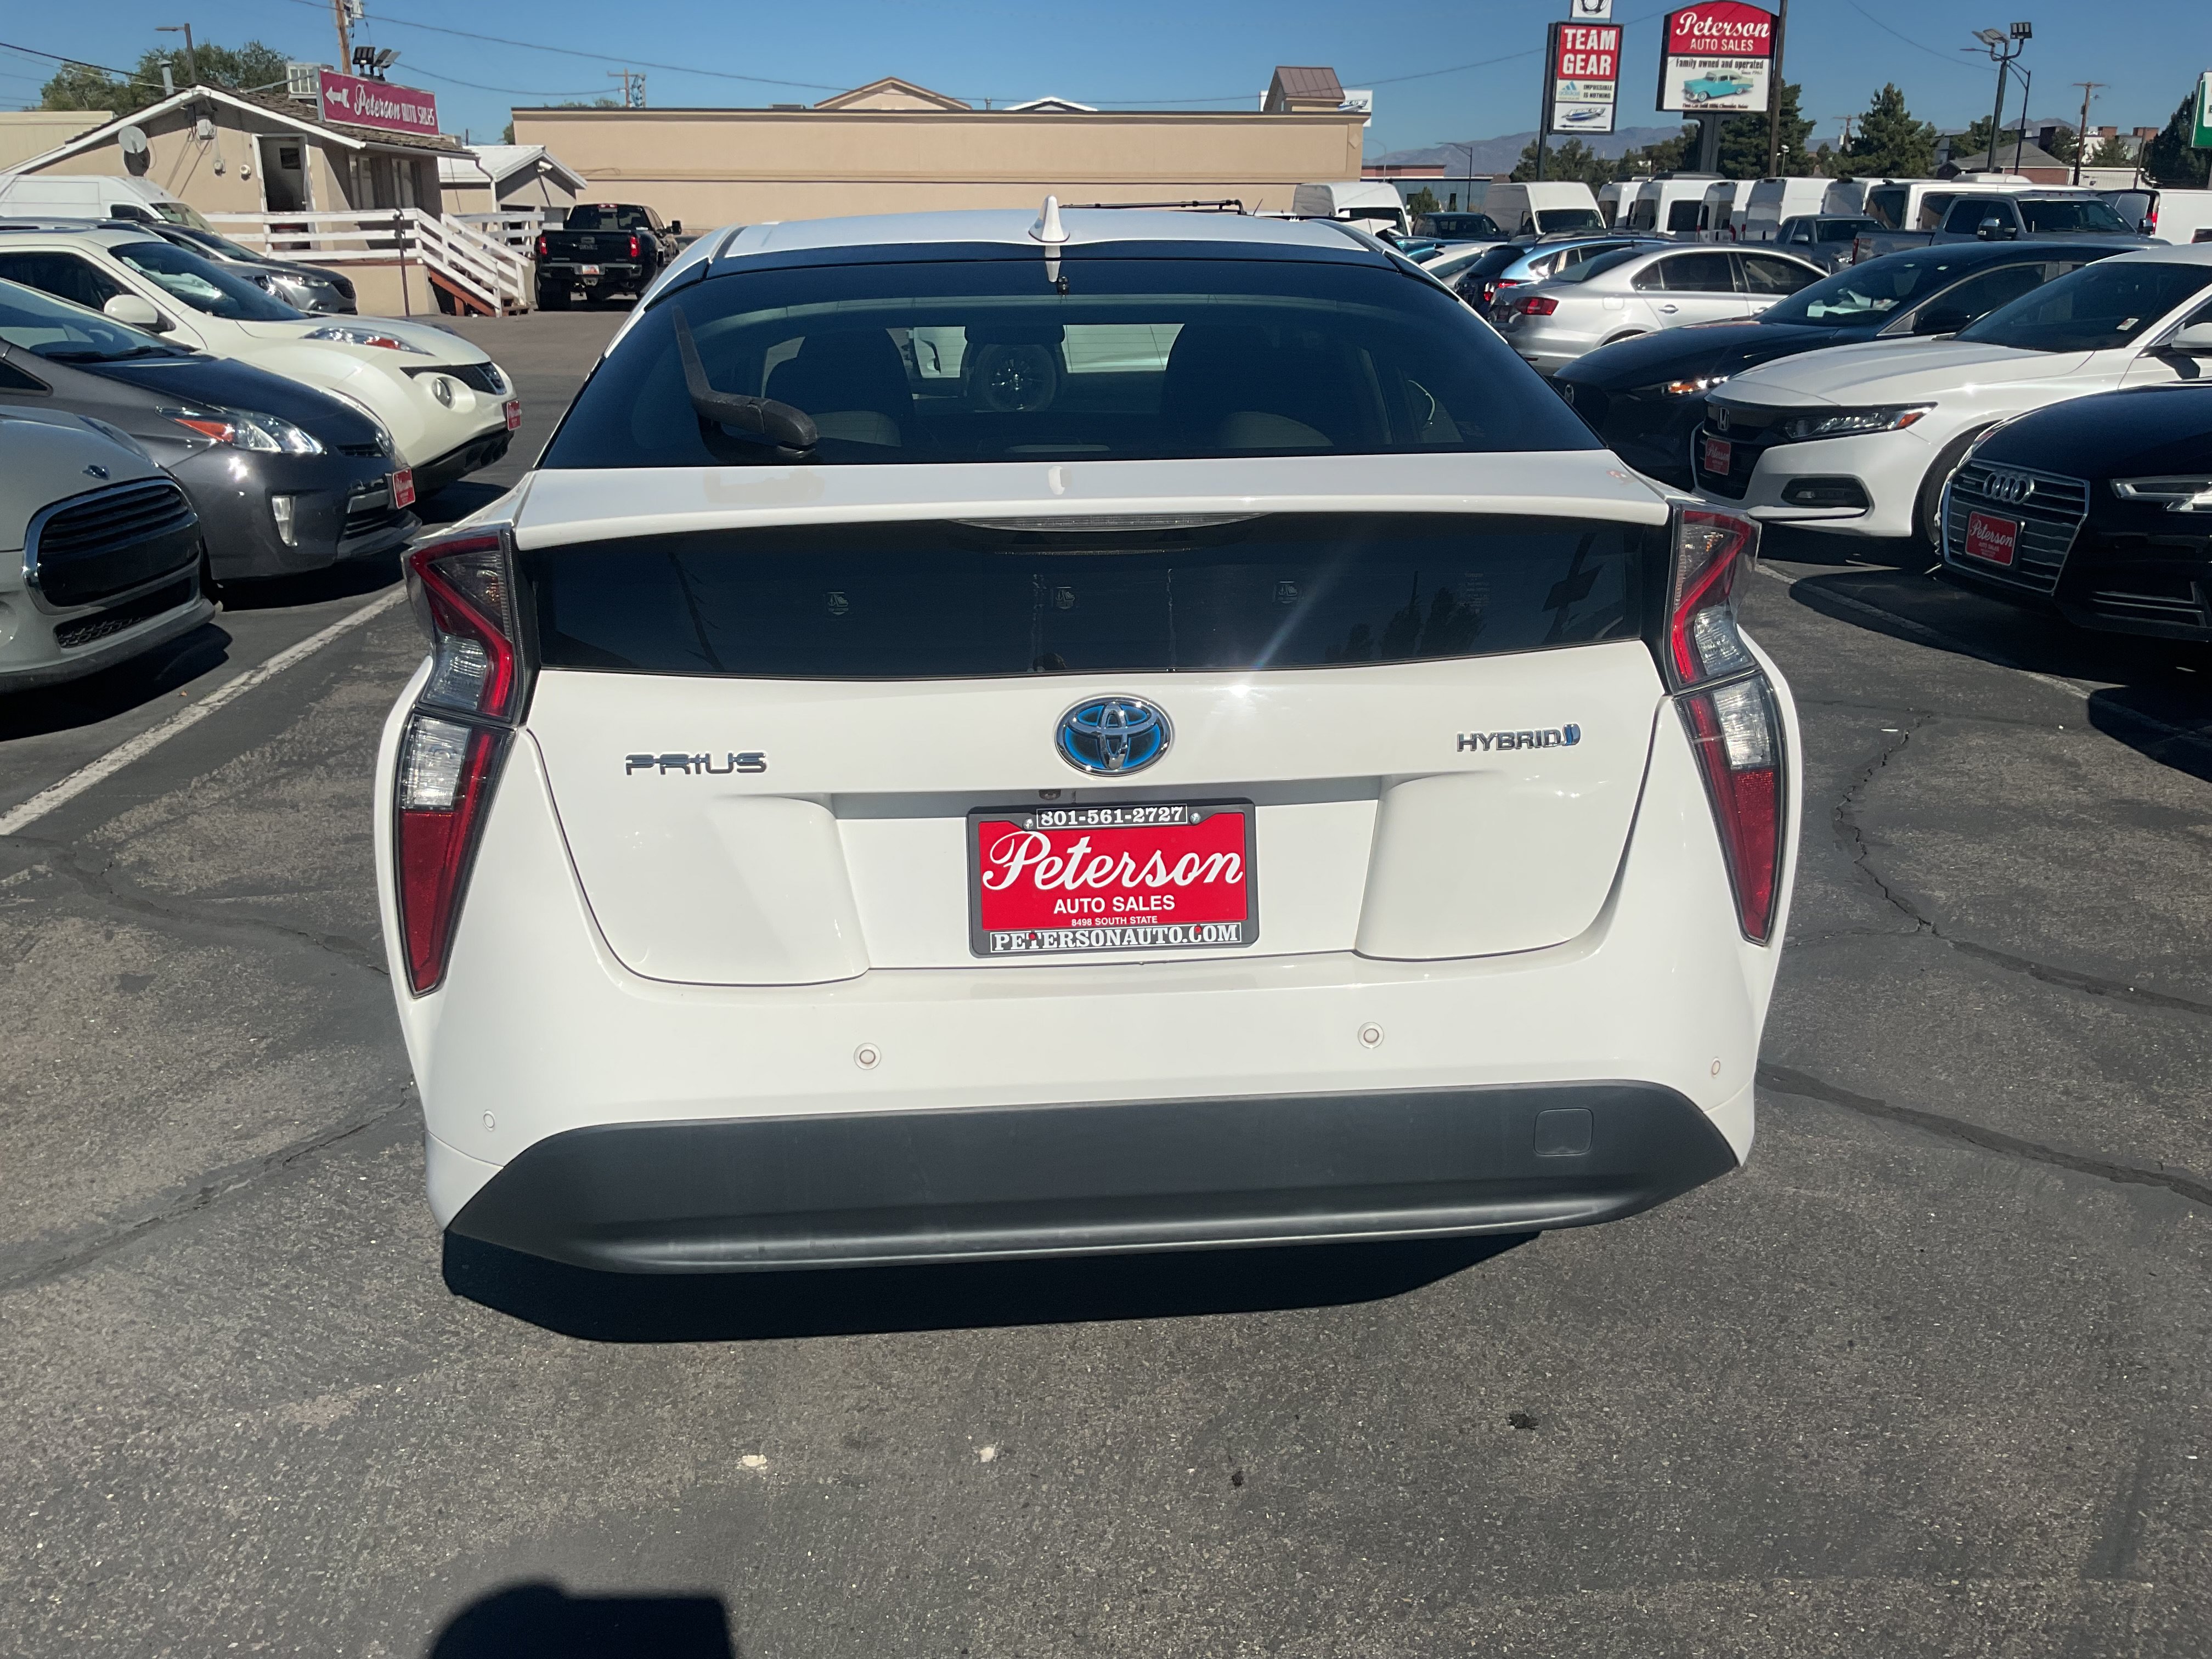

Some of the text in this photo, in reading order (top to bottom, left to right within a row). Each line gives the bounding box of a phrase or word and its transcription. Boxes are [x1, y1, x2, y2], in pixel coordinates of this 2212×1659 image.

[1676, 12, 1770, 38] Peterson
[1565, 29, 1616, 50] TEAM
[1690, 38, 1754, 51] AUTO SALES
[1562, 53, 1611, 75] GEAR
[1675, 58, 1764, 70] Family owned and operated
[354, 83, 435, 126] Peterson AUTO SALES
[1970, 519, 2013, 547] Peterson
[1457, 730, 1561, 752] HYBRID
[1041, 806, 1183, 826] 801-561-2727
[983, 830, 1243, 890] Peterson
[1053, 895, 1175, 914] AUTO SALES
[1071, 916, 1158, 927] 8498 SOUTH STATE
[994, 924, 1238, 951] PETERSONAUTO.COM
